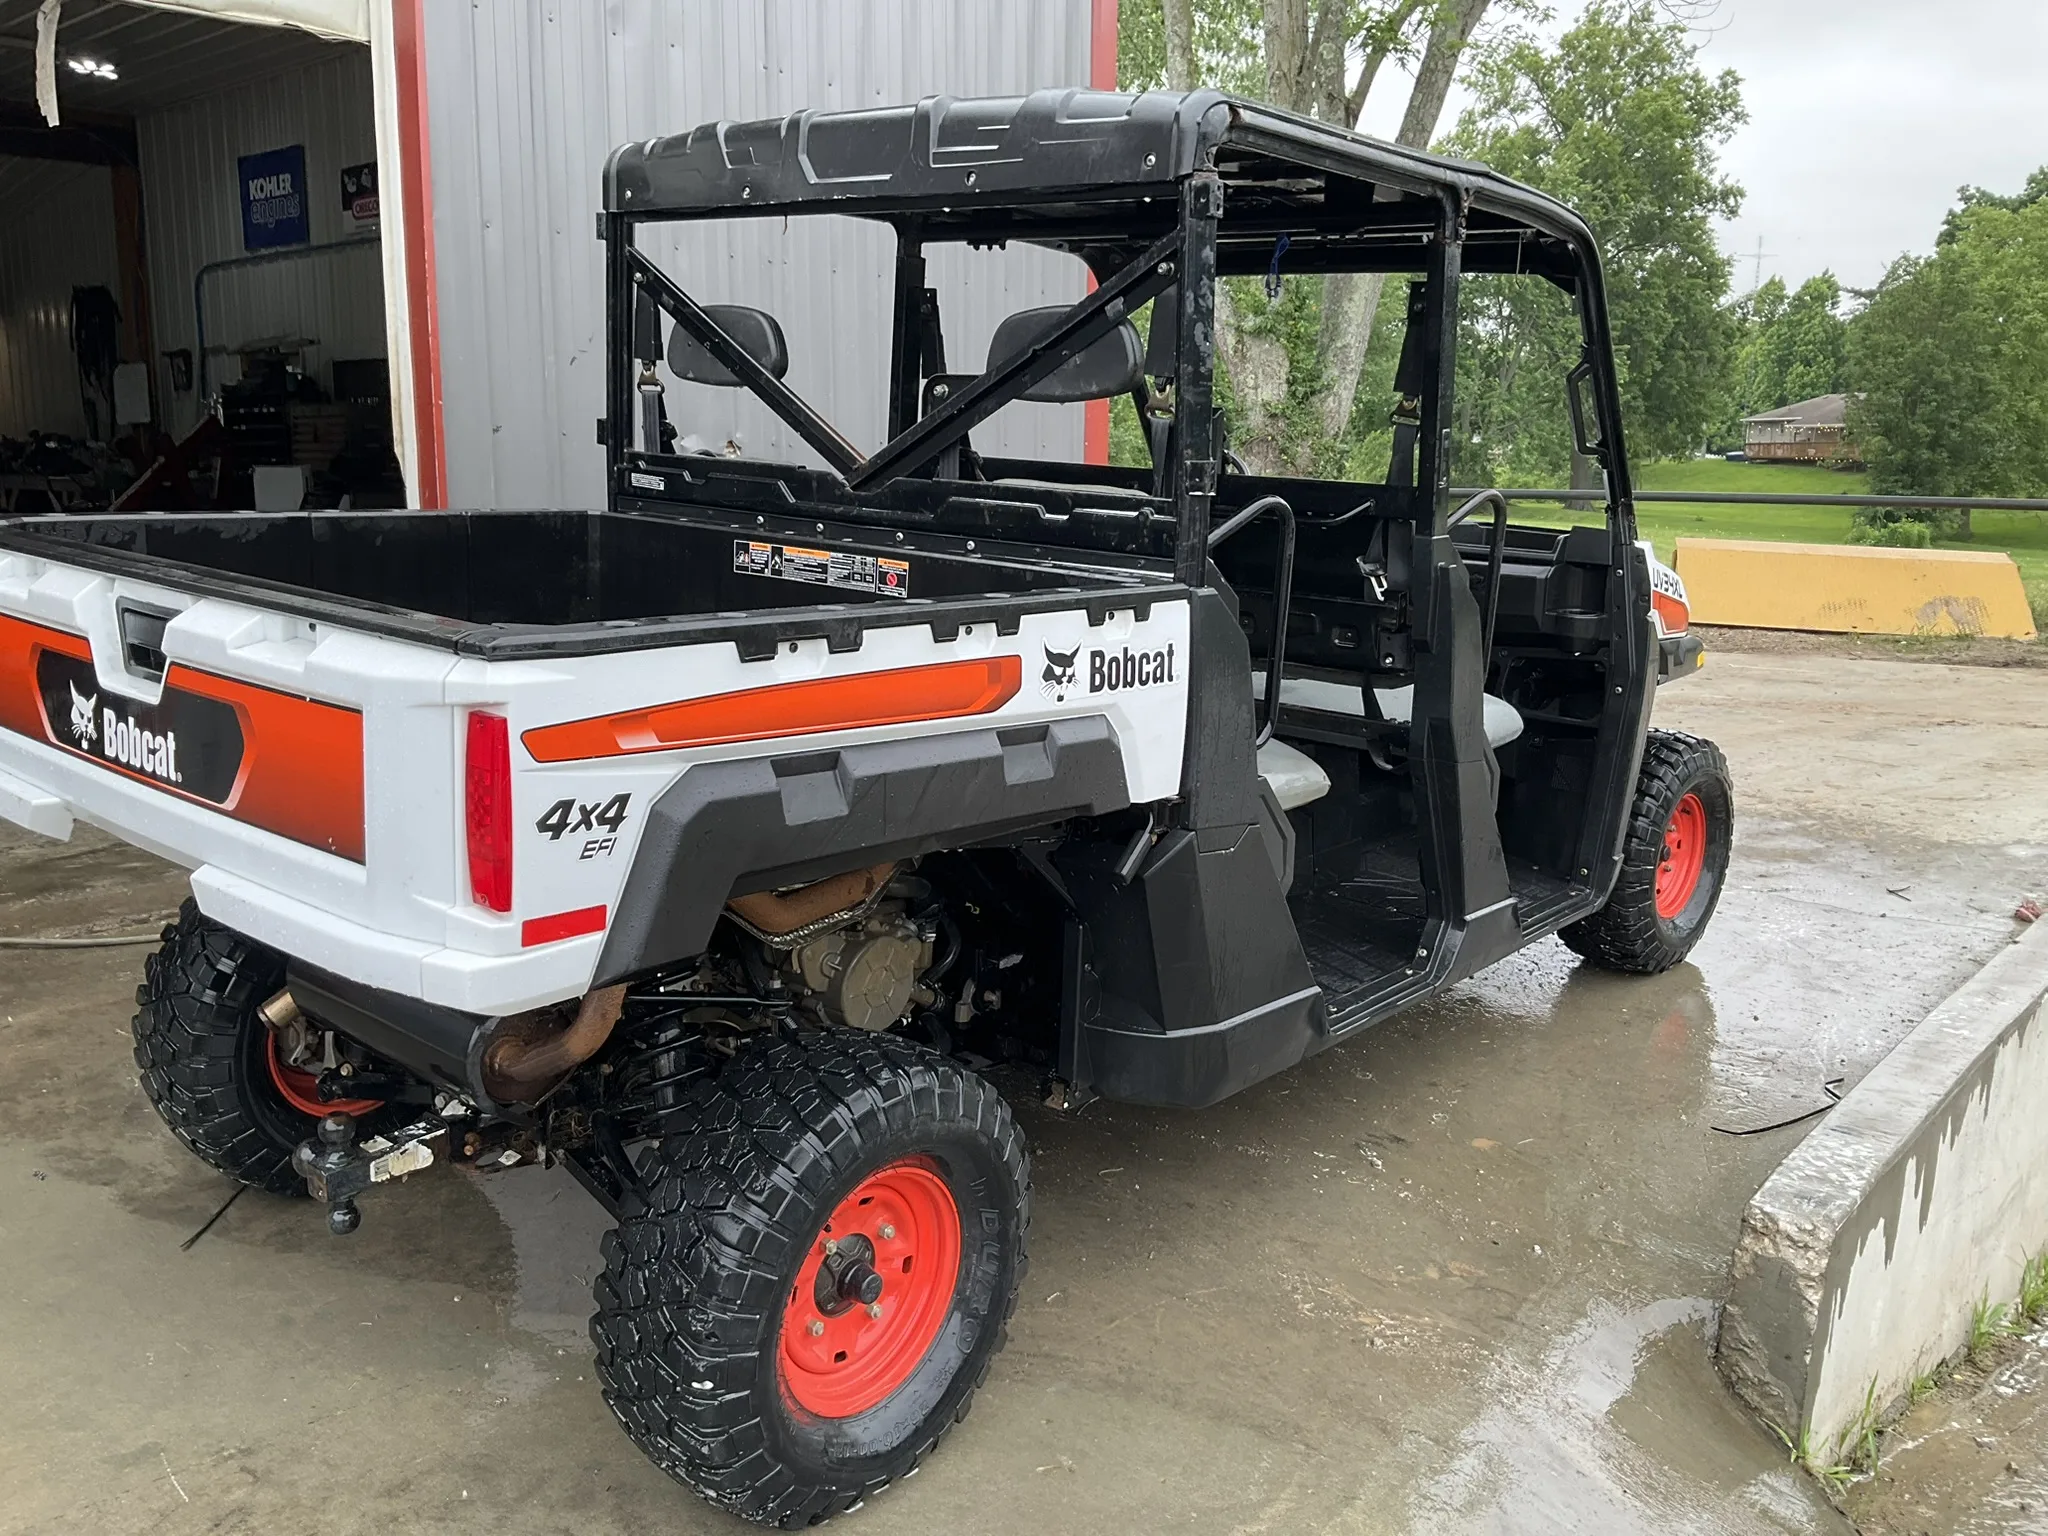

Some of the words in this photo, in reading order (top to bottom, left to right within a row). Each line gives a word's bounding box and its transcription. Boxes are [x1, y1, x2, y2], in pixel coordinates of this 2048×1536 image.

[249, 173, 293, 200] KOHLER
[250, 194, 300, 228] engines
[355, 200, 379, 214] OREGO
[1652, 567, 1683, 599] UV34XL
[1088, 642, 1174, 694] Bobcat
[103, 707, 177, 782] Bobcat
[535, 792, 632, 841] 4x4
[578, 836, 618, 860] EFI
